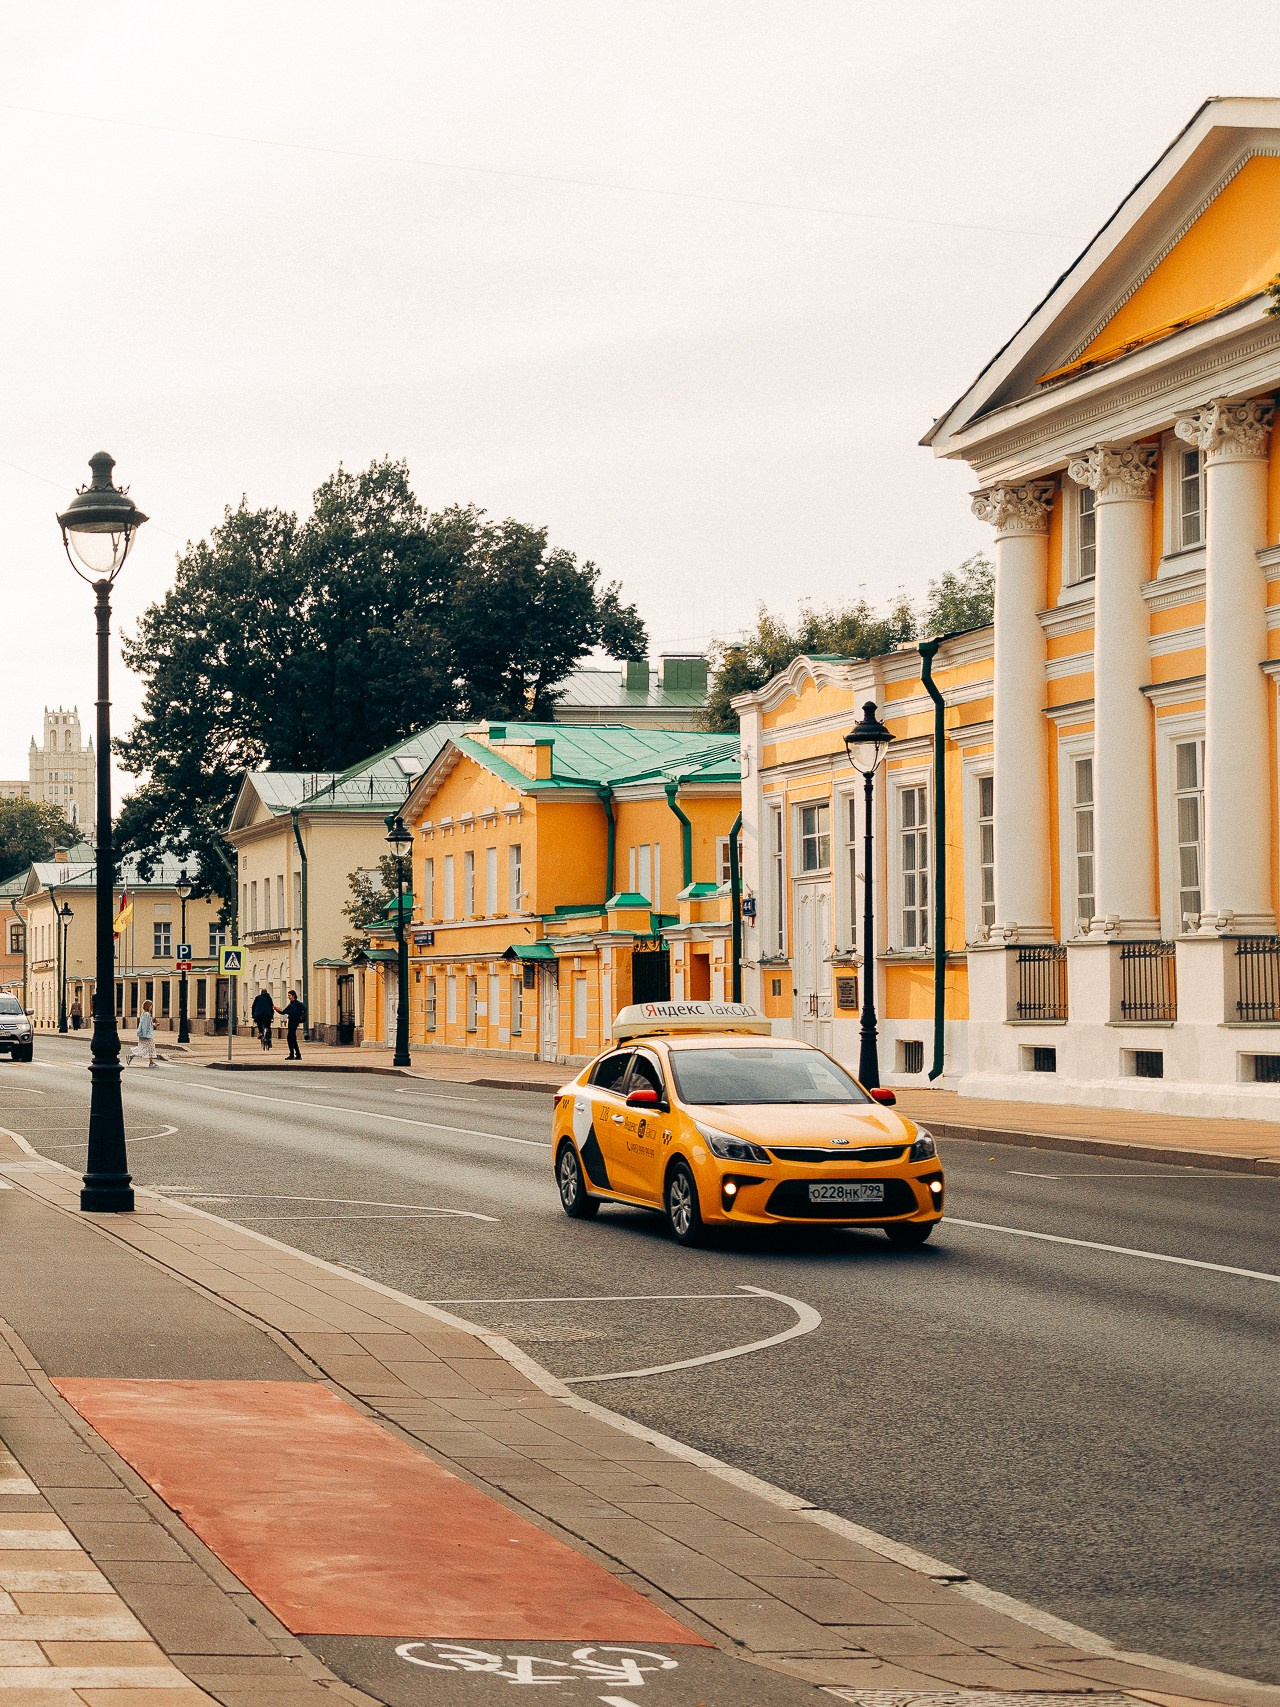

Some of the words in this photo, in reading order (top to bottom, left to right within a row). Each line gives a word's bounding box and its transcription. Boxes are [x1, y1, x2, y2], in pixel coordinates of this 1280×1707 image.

[180, 945, 189, 958] P
[645, 1004, 705, 1017] Яндекс
[706, 1002, 750, 1016] Такси
[861, 1185, 881, 1195] 799
